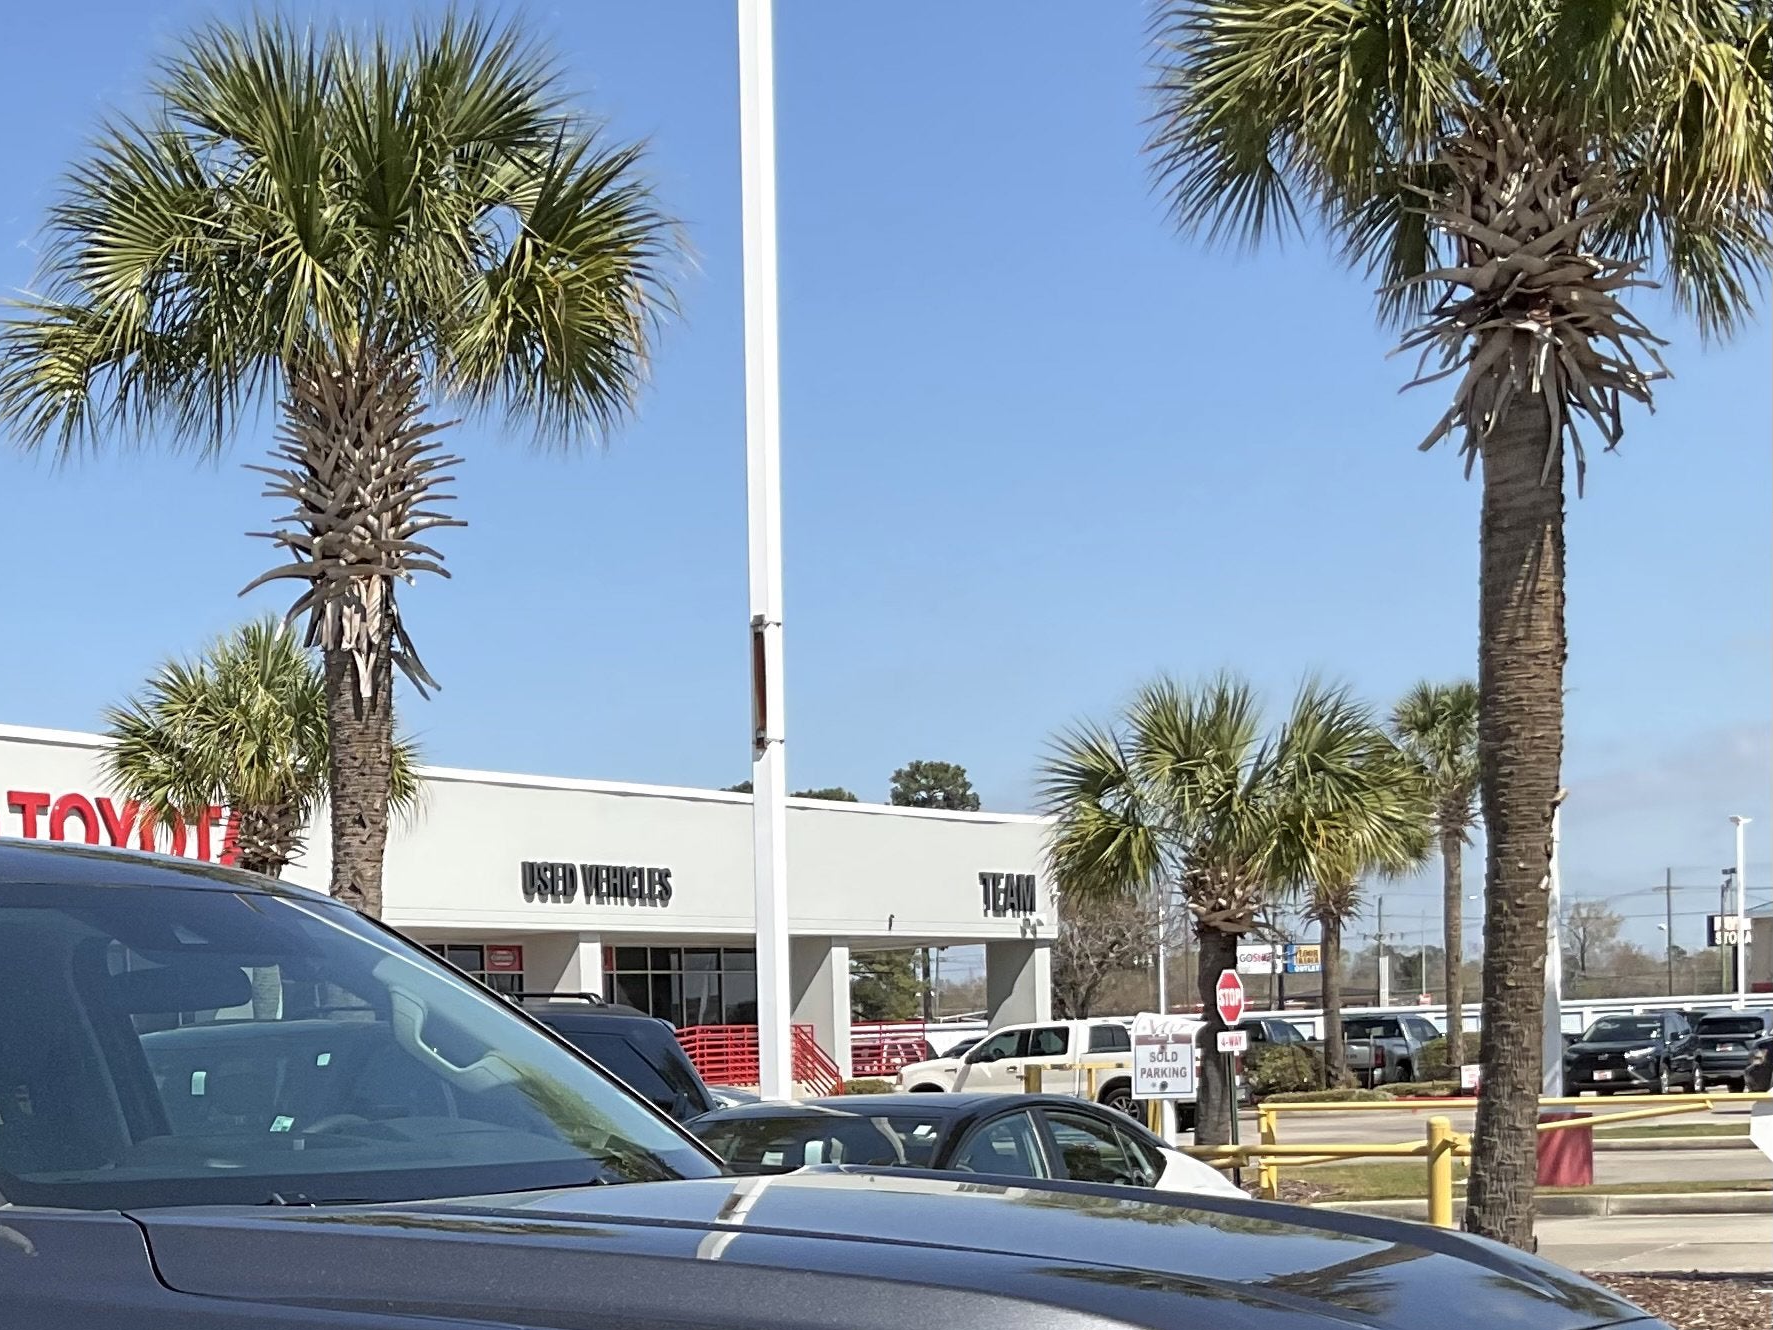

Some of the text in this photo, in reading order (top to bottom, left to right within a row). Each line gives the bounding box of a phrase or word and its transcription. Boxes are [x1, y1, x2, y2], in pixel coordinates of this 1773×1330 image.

[521, 861, 673, 904] USED VEHICLES
[978, 871, 1036, 914] TEAM
[1218, 988, 1241, 1007] STOP
[1221, 1036, 1242, 1047] 4-WAY
[1149, 1052, 1179, 1063] SOLD
[1140, 1067, 1188, 1079] PARKING
